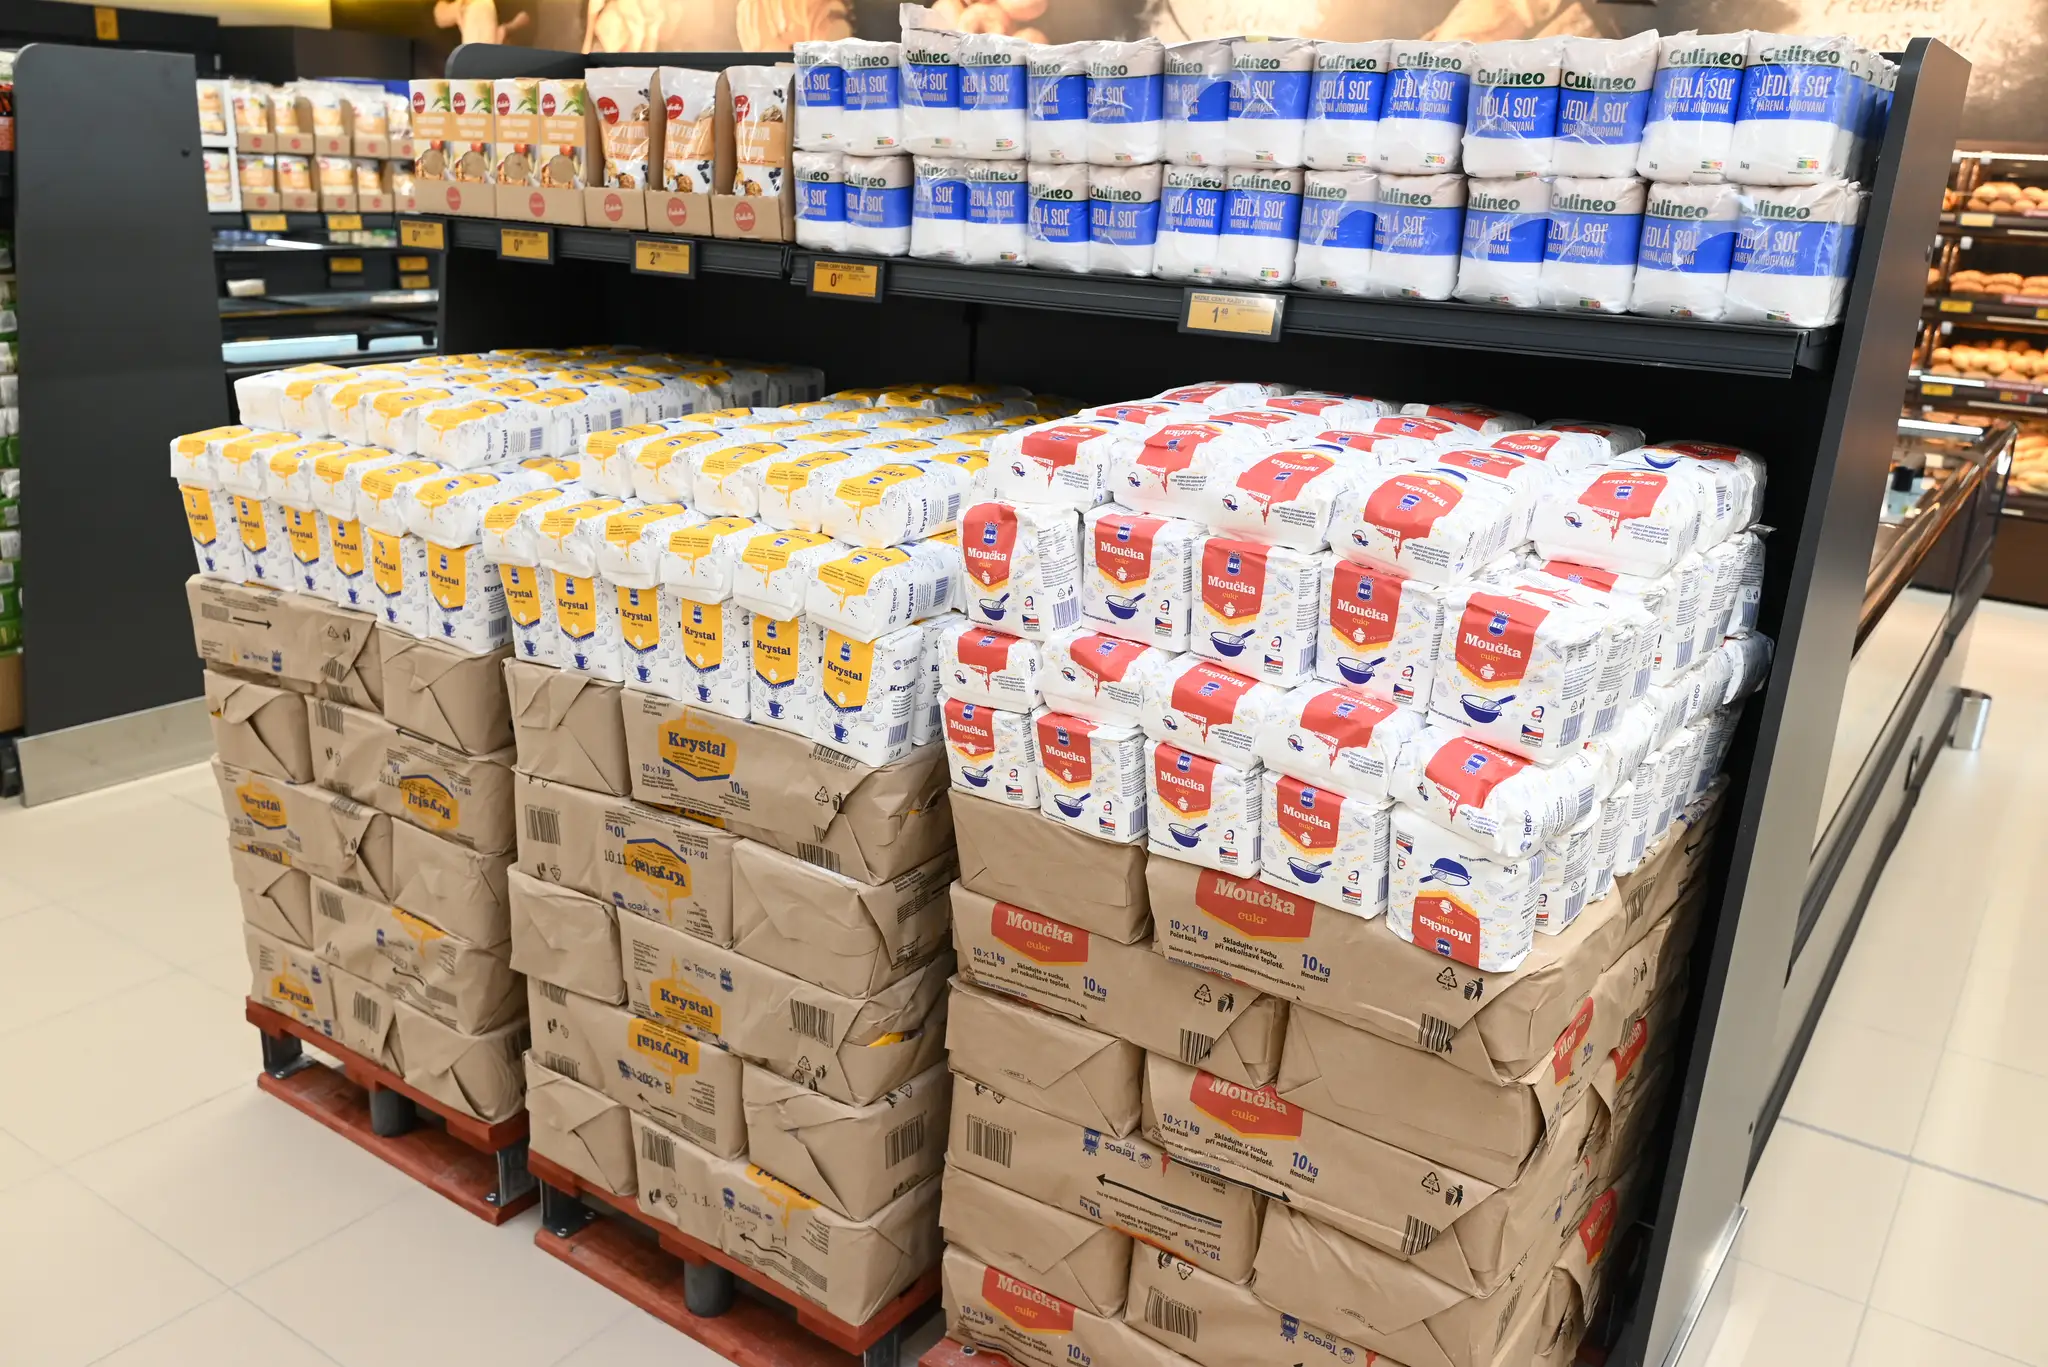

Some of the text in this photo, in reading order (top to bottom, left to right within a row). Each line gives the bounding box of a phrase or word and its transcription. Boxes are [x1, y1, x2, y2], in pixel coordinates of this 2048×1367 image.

[1318, 54, 1377, 70] Culineo
[1397, 52, 1462, 71] Culineo
[1668, 48, 1743, 67] Culineo
[1760, 45, 1840, 64] Culineo
[1478, 68, 1545, 85] Culineo
[1564, 71, 1636, 89] Culineo
[1665, 72, 1735, 100] JEDLÁ SOĽ
[1757, 72, 1832, 98] JEDLÁ SOĽ
[1316, 77, 1372, 101] JEDLÁ SOĽ
[1431, 81, 1455, 101] SOĽ
[1476, 93, 1538, 118] JEDLÁ SOĽ
[1562, 97, 1629, 124] JEDLÁ SOĽ
[1168, 172, 1222, 189] Culineo
[1233, 174, 1291, 191] Culineo
[936, 187, 954, 203] SOĽ
[996, 190, 1015, 207] SOĽ
[1090, 184, 1141, 201] Culineo
[1166, 191, 1217, 217] JEDLÁ SOĽ
[1230, 194, 1286, 220] JEDLÁ SOĽ
[1552, 193, 1616, 213] Culineo
[1051, 207, 1070, 226] SOĽ
[1092, 205, 1138, 228] JEDLÁ SOĽ
[1403, 214, 1425, 235] SOĽ
[1548, 217, 1608, 245] JEDLÁ SOĽ
[1772, 231, 1801, 253] SOĽ
[919, 498, 927, 533] Krystal
[289, 527, 313, 540] Krystal
[334, 539, 357, 551] Krystal
[967, 547, 1007, 561] Moučka
[1101, 541, 1144, 561] Moučka
[374, 557, 396, 572] Krystal
[431, 570, 459, 586] Krystal
[1207, 575, 1256, 595] Moučka
[558, 599, 588, 611] Krystal
[905, 582, 914, 620] Krystal
[1337, 598, 1388, 623] Moučka
[622, 609, 652, 622] Krystal
[1352, 616, 1370, 627] cukr
[684, 626, 716, 640] Krystal
[756, 640, 791, 656] Krystal
[1464, 631, 1522, 659] Moučka
[827, 661, 862, 681] Krystal
[903, 656, 918, 667] Tereos
[889, 679, 916, 691] Krystal
[1692, 684, 1701, 711] Tereos
[950, 719, 988, 738] Moučka
[668, 731, 727, 758] Krystal
[1045, 745, 1086, 765] Moučka
[642, 763, 650, 772] 10
[662, 767, 671, 778] kg
[729, 781, 749, 799] 10 kg
[1161, 771, 1205, 793] Moučka
[408, 792, 451, 820] Krystal
[1283, 803, 1331, 830] Moučka
[614, 826, 626, 838] 10
[1214, 877, 1296, 916] Moučka
[1006, 909, 1074, 945] Moučka
[1238, 911, 1267, 926] cukr
[1169, 919, 1181, 930] 10
[1197, 927, 1209, 940] kg
[1169, 930, 1198, 943] Počet kusů
[1420, 914, 1472, 945] Moučka
[973, 947, 981, 956] 10
[996, 952, 1005, 965] kg
[1026, 940, 1051, 953] cukr
[1214, 941, 1285, 970] při nekolísavé teplotě.
[1222, 936, 1253, 953] Skladujte
[1259, 947, 1278, 960] suchu
[1017, 962, 1042, 975] Skladujte
[1048, 972, 1064, 982] suchu
[1301, 953, 1331, 977] 10 kg
[1011, 967, 1071, 990] při nekolísavé teplotě.
[1083, 976, 1107, 997] 10 kg
[1300, 970, 1329, 984] Hmotnost
[660, 987, 714, 1018] Krystal
[1083, 990, 1106, 1003] Hmotnost
[637, 1034, 689, 1066] Krystal
[1208, 1078, 1288, 1116] Moučka
[1162, 1112, 1173, 1124] 10
[1189, 1121, 1200, 1135] kg
[1231, 1108, 1260, 1123] cukr
[1161, 1124, 1189, 1138] Počet kusů
[1104, 1141, 1136, 1162] Tereos
[1205, 1137, 1274, 1167] při nekolísavé teplotě.
[1214, 1132, 1243, 1148] Skladujte
[1250, 1146, 1268, 1157] suchu
[1292, 1151, 1319, 1177] 10 kg
[1290, 1169, 1315, 1184] Hmotnost
[1089, 1206, 1102, 1219] 10
[997, 1273, 1061, 1313] Moučka
[1014, 1304, 1038, 1319] cukr
[1303, 1330, 1338, 1356] Tereos
[1067, 1344, 1091, 1366] 10 kg
